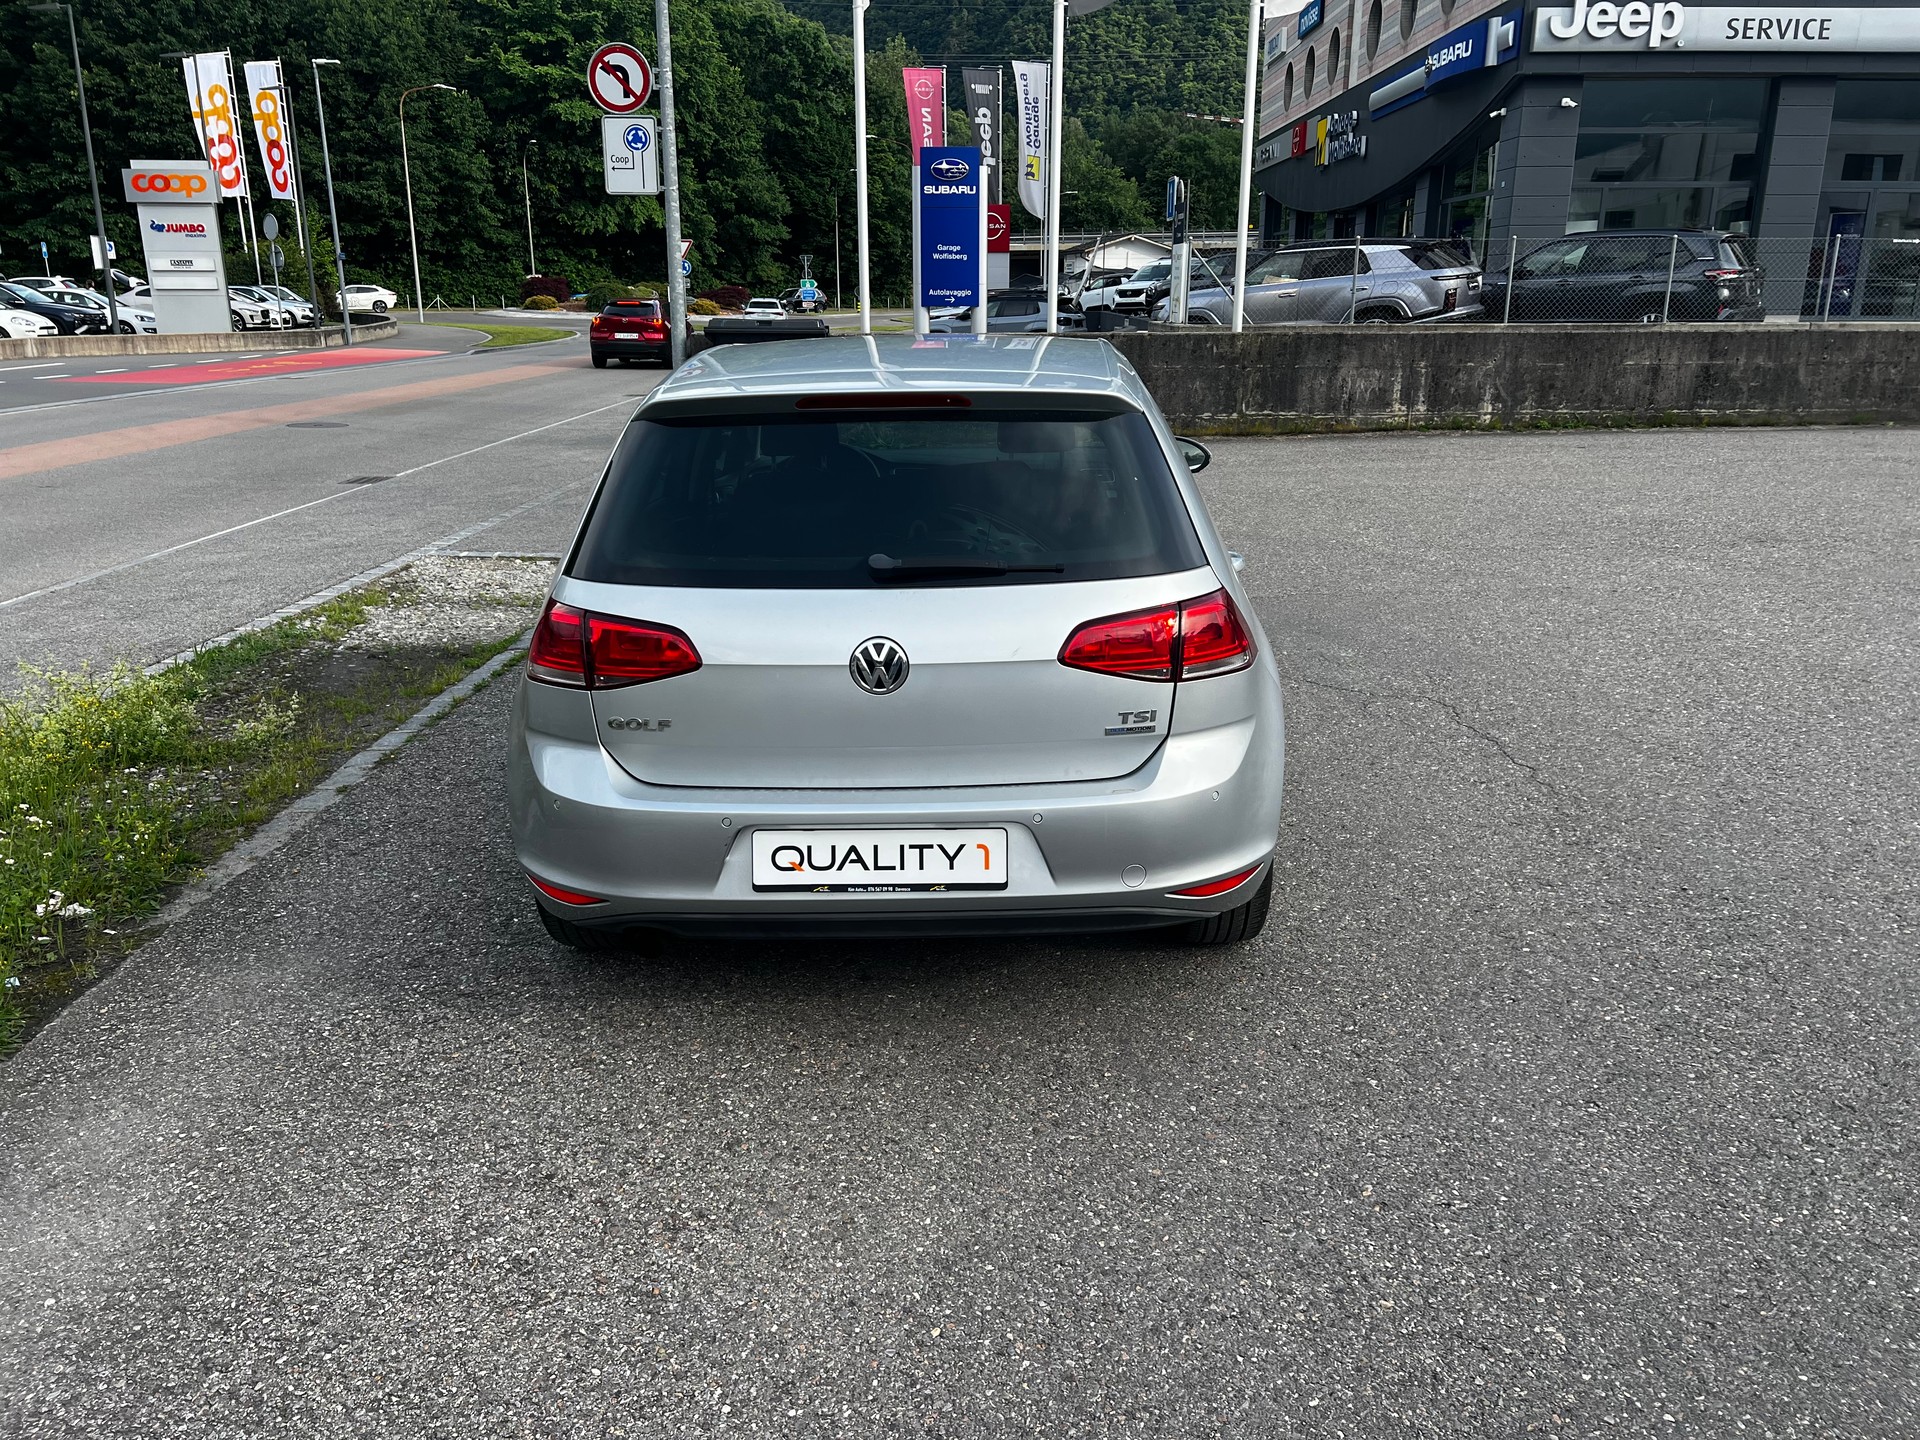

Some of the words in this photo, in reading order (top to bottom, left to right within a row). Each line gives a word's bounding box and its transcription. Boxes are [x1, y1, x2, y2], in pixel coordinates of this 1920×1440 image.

[1550, 0, 1684, 48] Jeep
[1725, 17, 1832, 40] SERVICE
[1432, 38, 1473, 71] SUBARU
[610, 154, 630, 165] Coop
[131, 173, 207, 198] coop
[923, 185, 976, 194] SUBARU
[165, 223, 205, 233] JUMBO
[936, 244, 961, 252] Garage
[932, 252, 968, 261] Wolfisberg
[928, 288, 972, 297] Autolavaggio
[608, 716, 672, 732] GOLF
[1118, 709, 1157, 724] TSI
[771, 843, 966, 872] QUALITY
[976, 843, 990, 871] 1
